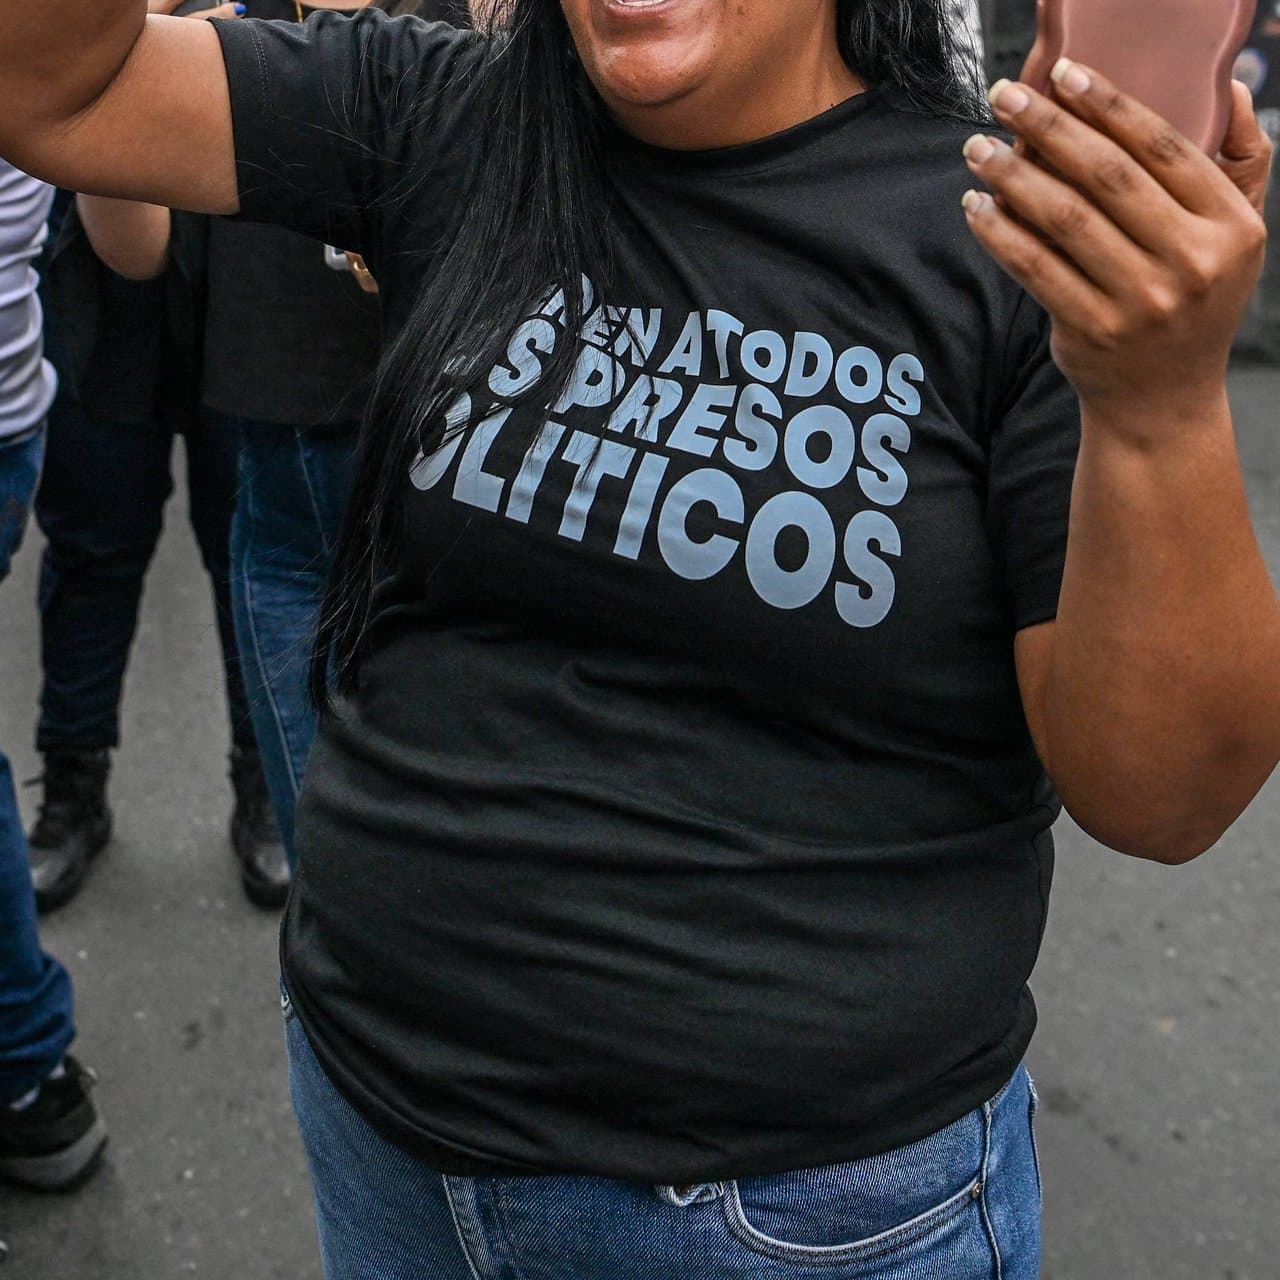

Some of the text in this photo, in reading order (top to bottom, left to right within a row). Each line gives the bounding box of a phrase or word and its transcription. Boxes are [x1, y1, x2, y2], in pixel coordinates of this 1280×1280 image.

[546, 342, 913, 507] PRESOS
[656, 310, 702, 376] A
[706, 308, 925, 416] TODOS
